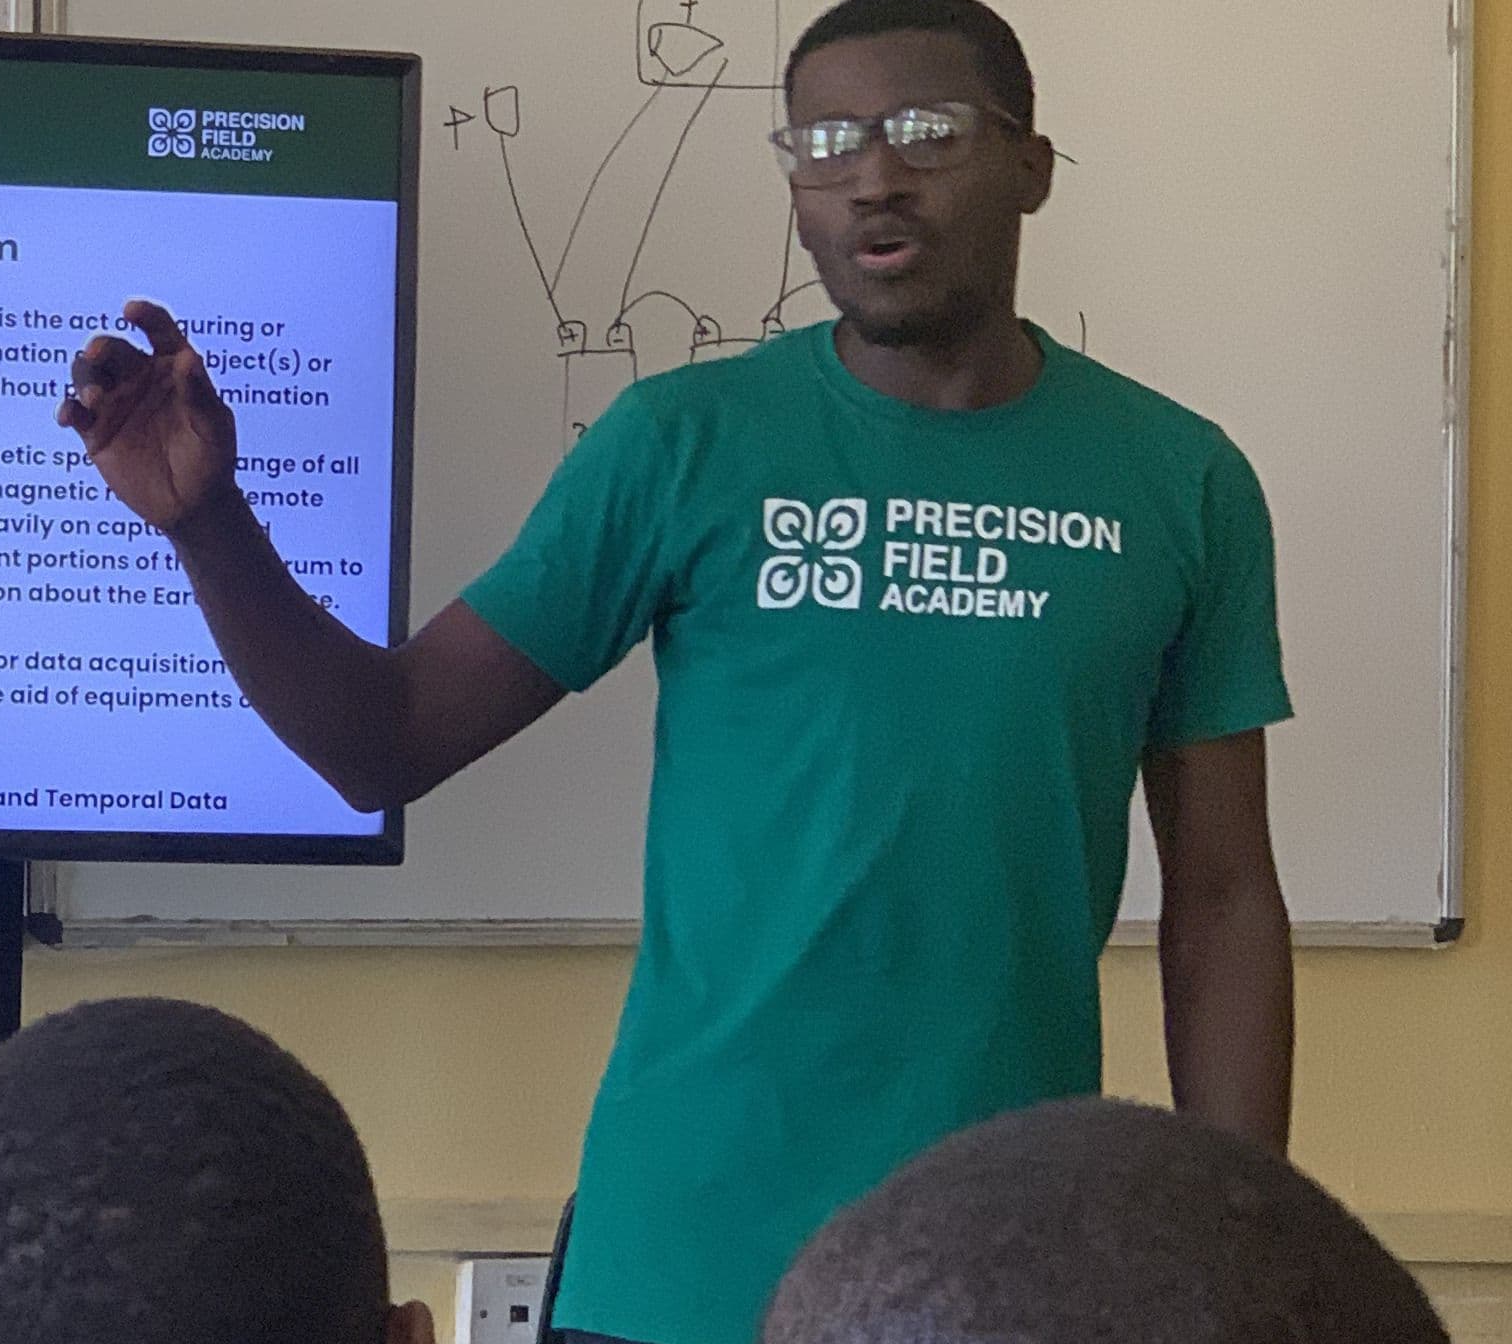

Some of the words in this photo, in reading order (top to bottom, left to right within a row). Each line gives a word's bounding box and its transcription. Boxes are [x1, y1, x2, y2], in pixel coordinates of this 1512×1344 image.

[201, 110, 305, 132] PRECISION
[201, 128, 257, 147] FIELD
[199, 146, 274, 162] ACADEMY
[23, 310, 63, 329] the
[68, 312, 110, 331] act
[260, 322, 286, 338] or
[206, 347, 301, 376] bject(s)
[307, 357, 333, 373] or
[220, 383, 330, 407] mination
[235, 456, 296, 479] ange
[302, 454, 326, 473] of
[330, 456, 360, 475] all
[245, 489, 324, 508] emote
[60, 519, 90, 535] on
[885, 497, 1123, 555] PRECISION
[26, 549, 129, 575] portions
[135, 550, 160, 571] of
[339, 558, 364, 577] to
[882, 540, 1009, 585] FIELD
[28, 582, 101, 605] about
[107, 585, 148, 605] the
[877, 582, 1051, 621] ACADEMY
[24, 651, 82, 671] data
[88, 652, 226, 679] acquisition
[9, 686, 49, 705] aid
[54, 685, 79, 706] of
[84, 686, 233, 714] equipments
[44, 788, 164, 816] Temporal
[169, 791, 228, 812] Data
